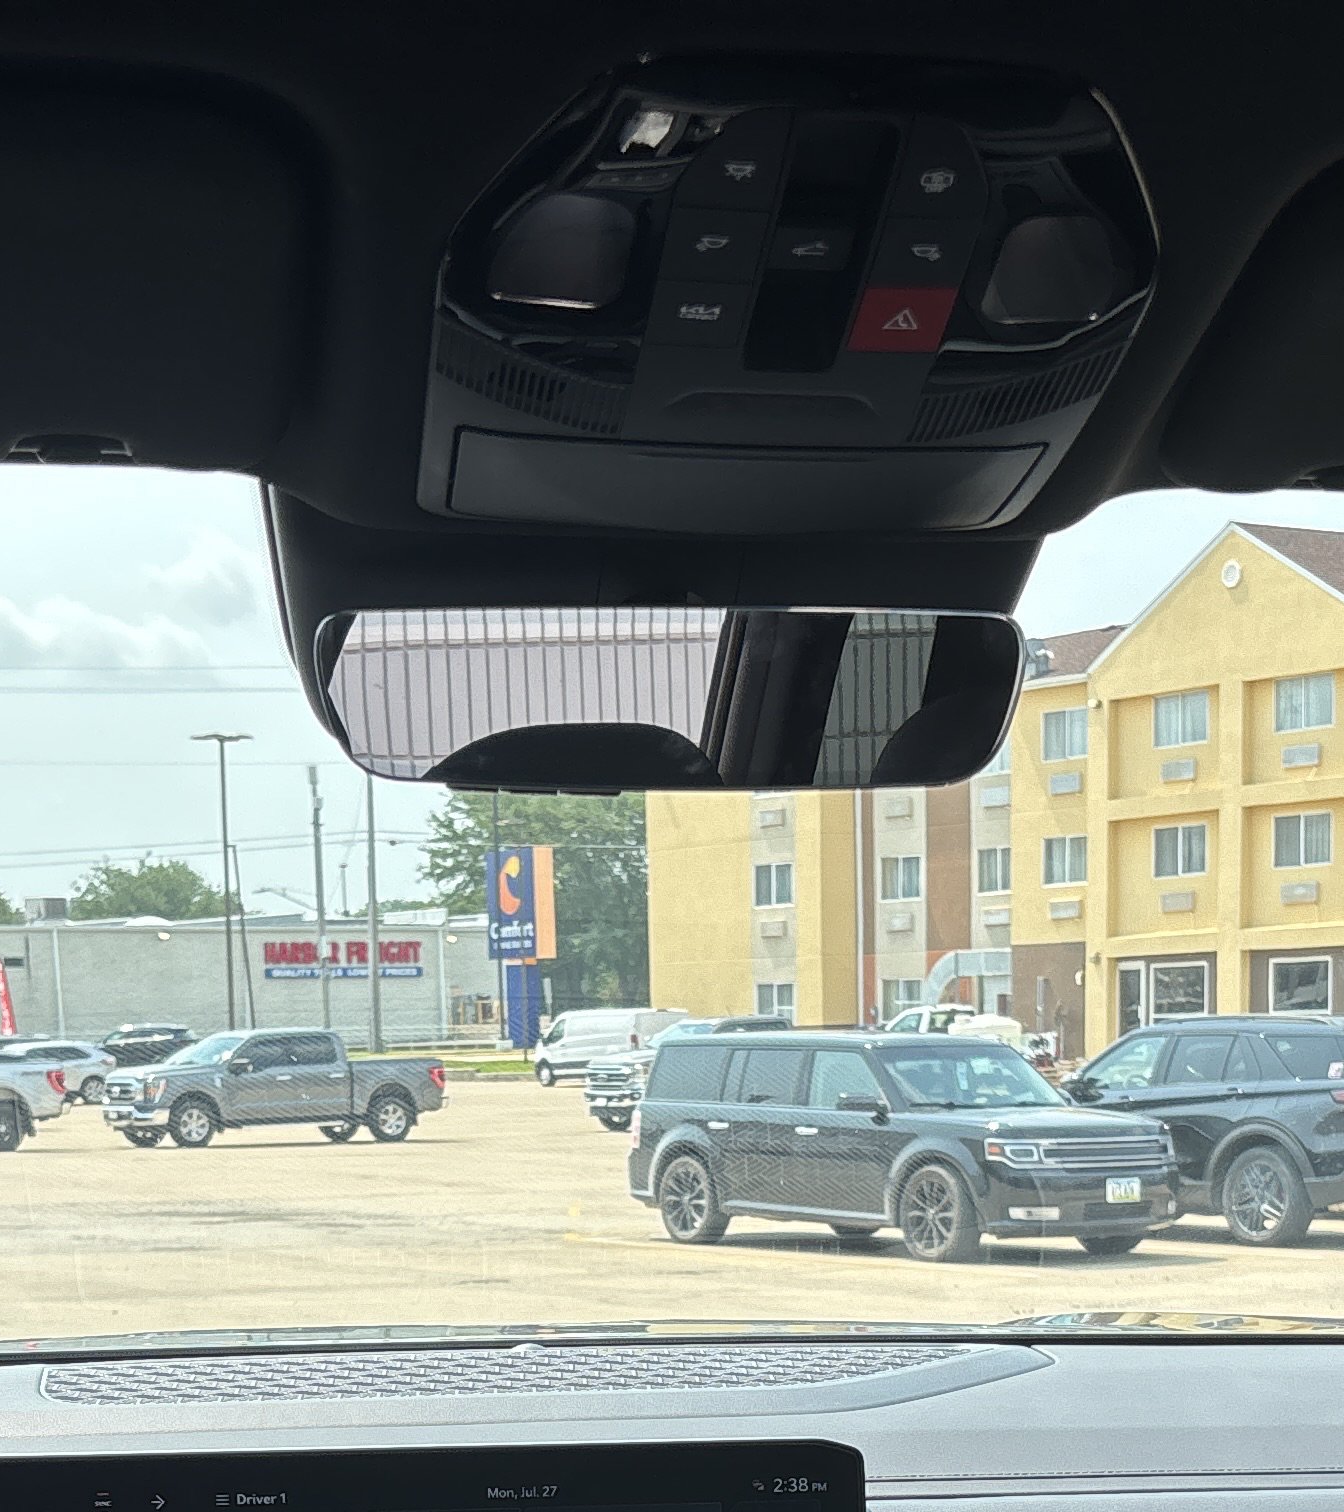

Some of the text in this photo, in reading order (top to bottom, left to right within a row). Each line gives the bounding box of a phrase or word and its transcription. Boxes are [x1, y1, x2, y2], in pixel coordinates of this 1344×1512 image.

[346, 940, 422, 964] FRIGHT
[487, 1485, 558, 1500] Mon, Jul. 27
[773, 1477, 828, 1493] 2:38 PM
[236, 1492, 287, 1505] Driver 1
